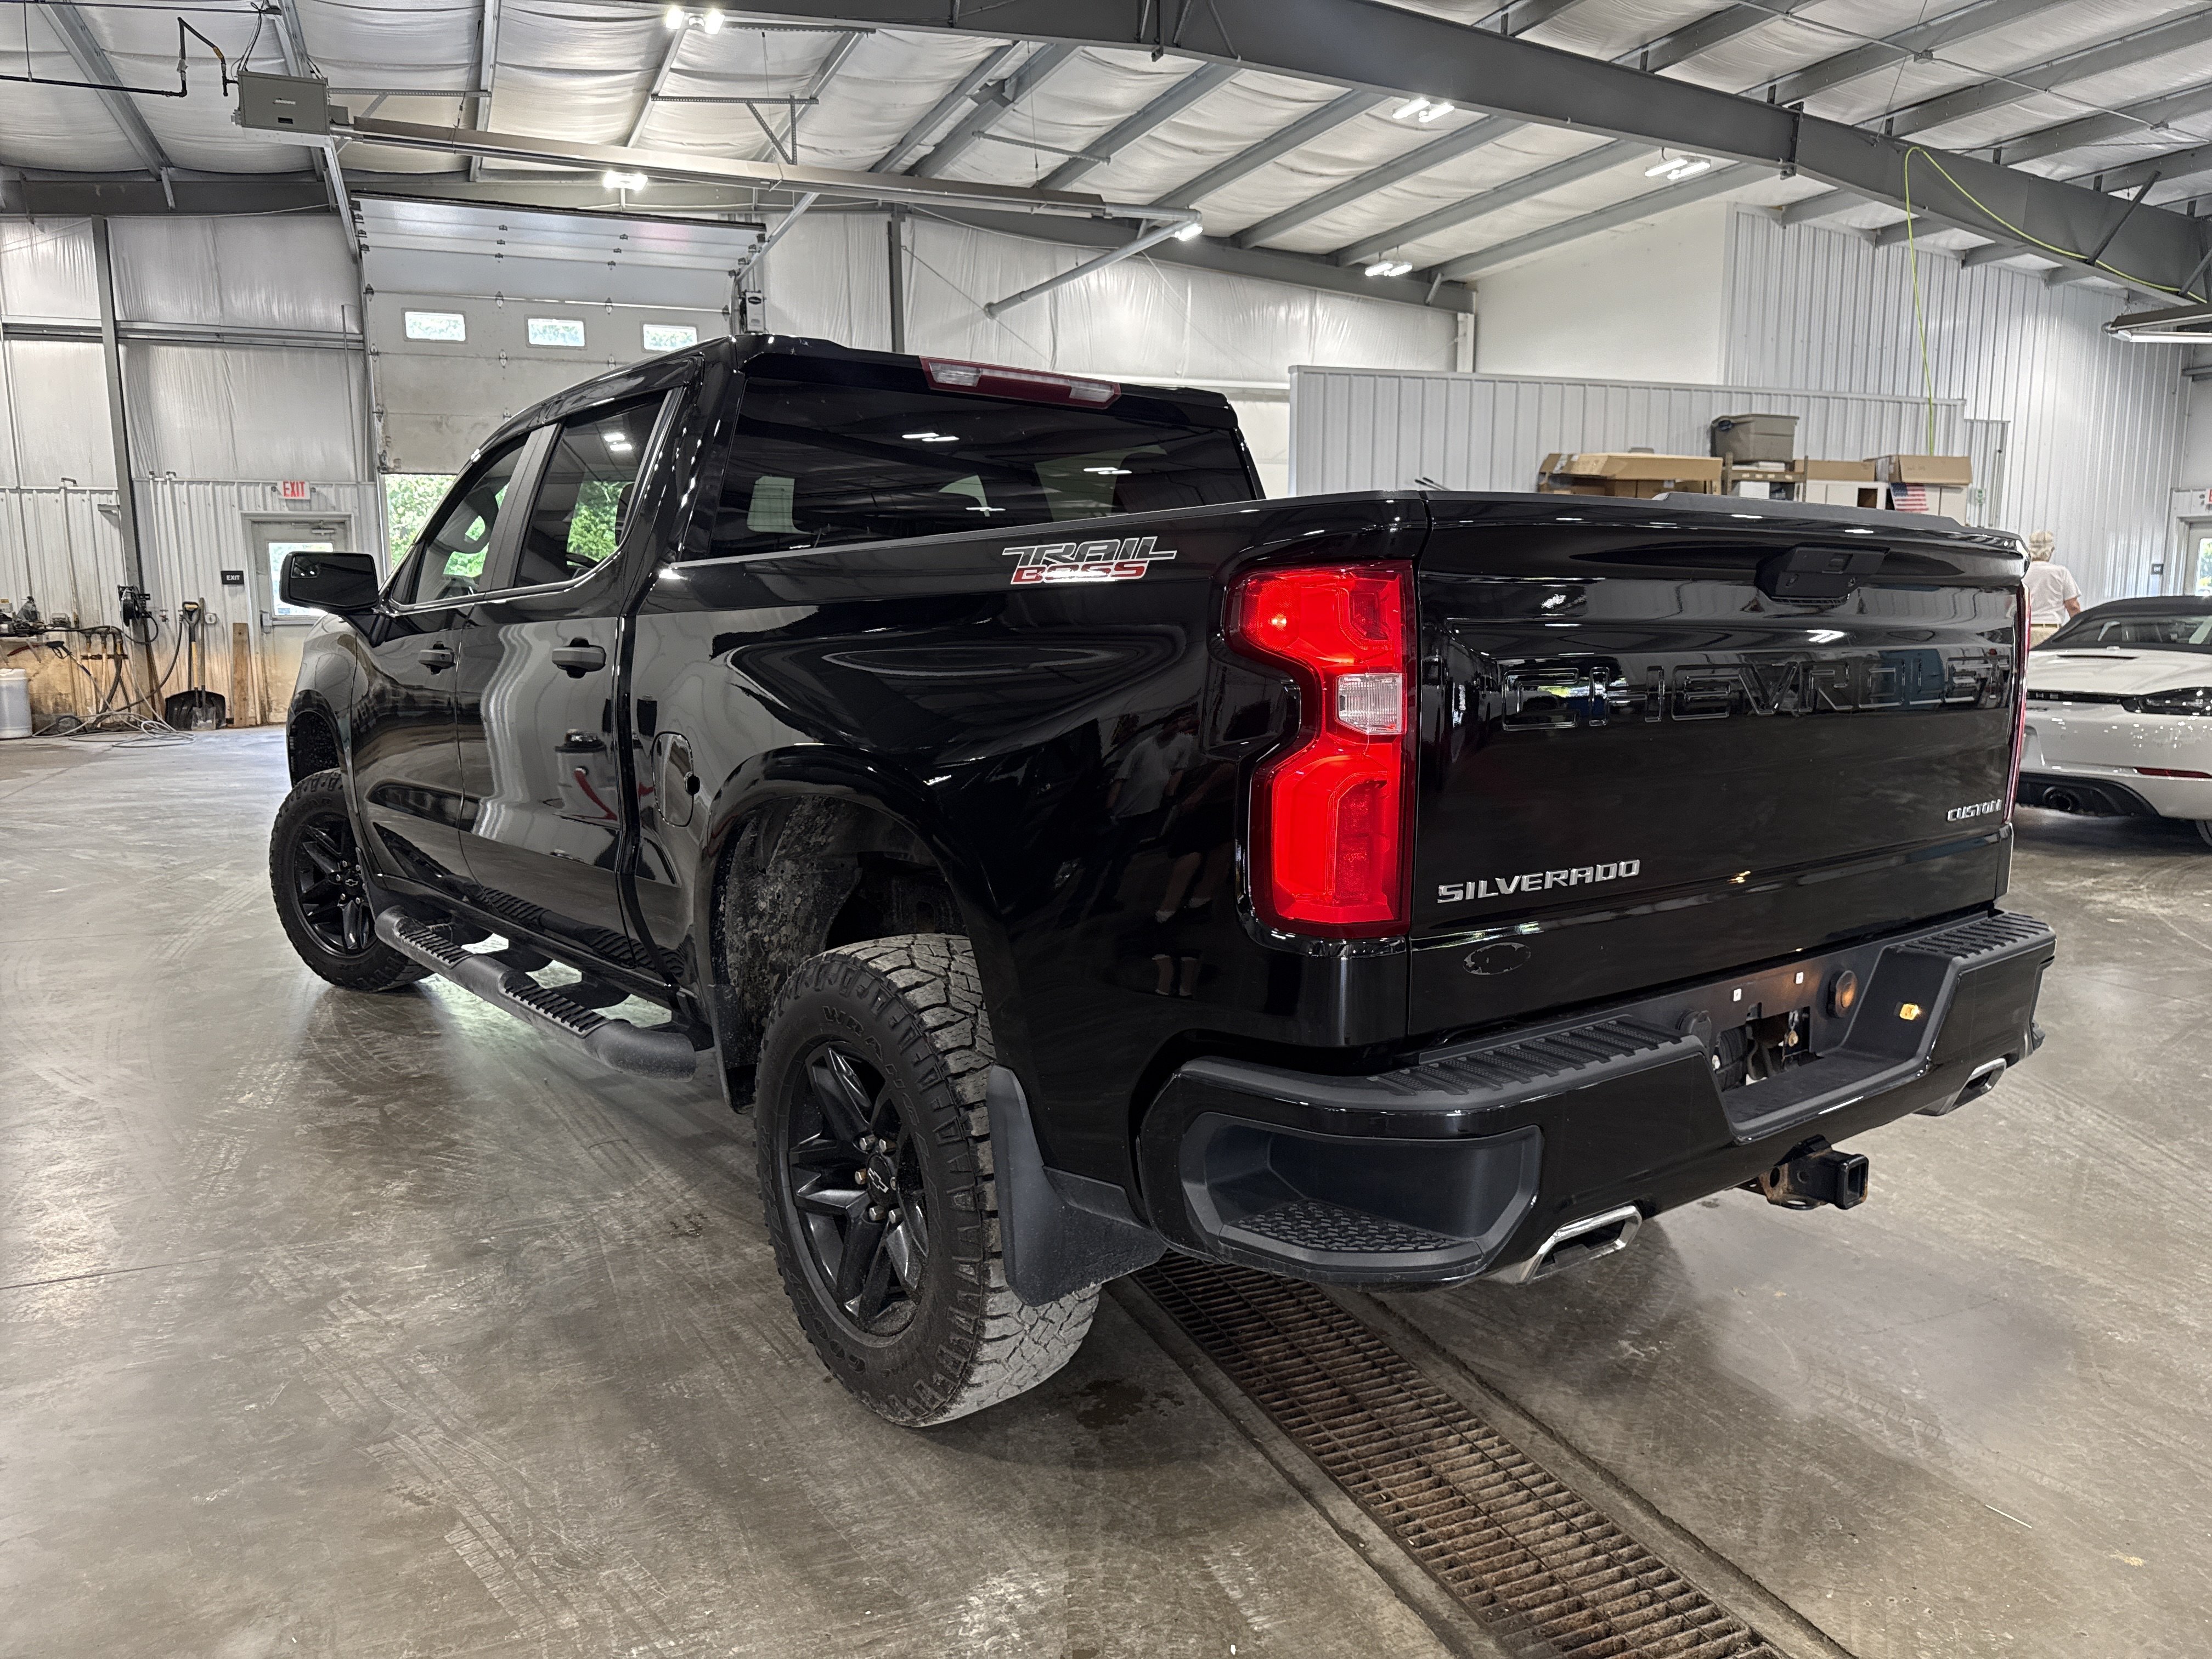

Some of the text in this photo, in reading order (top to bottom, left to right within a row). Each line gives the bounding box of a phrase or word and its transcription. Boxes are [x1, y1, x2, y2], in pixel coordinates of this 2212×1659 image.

[283, 481, 305, 497] EXIT
[1002, 536, 1177, 566] TRAIL
[1010, 560, 1149, 585] BOSS
[1501, 658, 2009, 731] CHEVROLET
[1948, 799, 2002, 821] CUSTOM
[1437, 859, 1640, 904] SILVERADO
